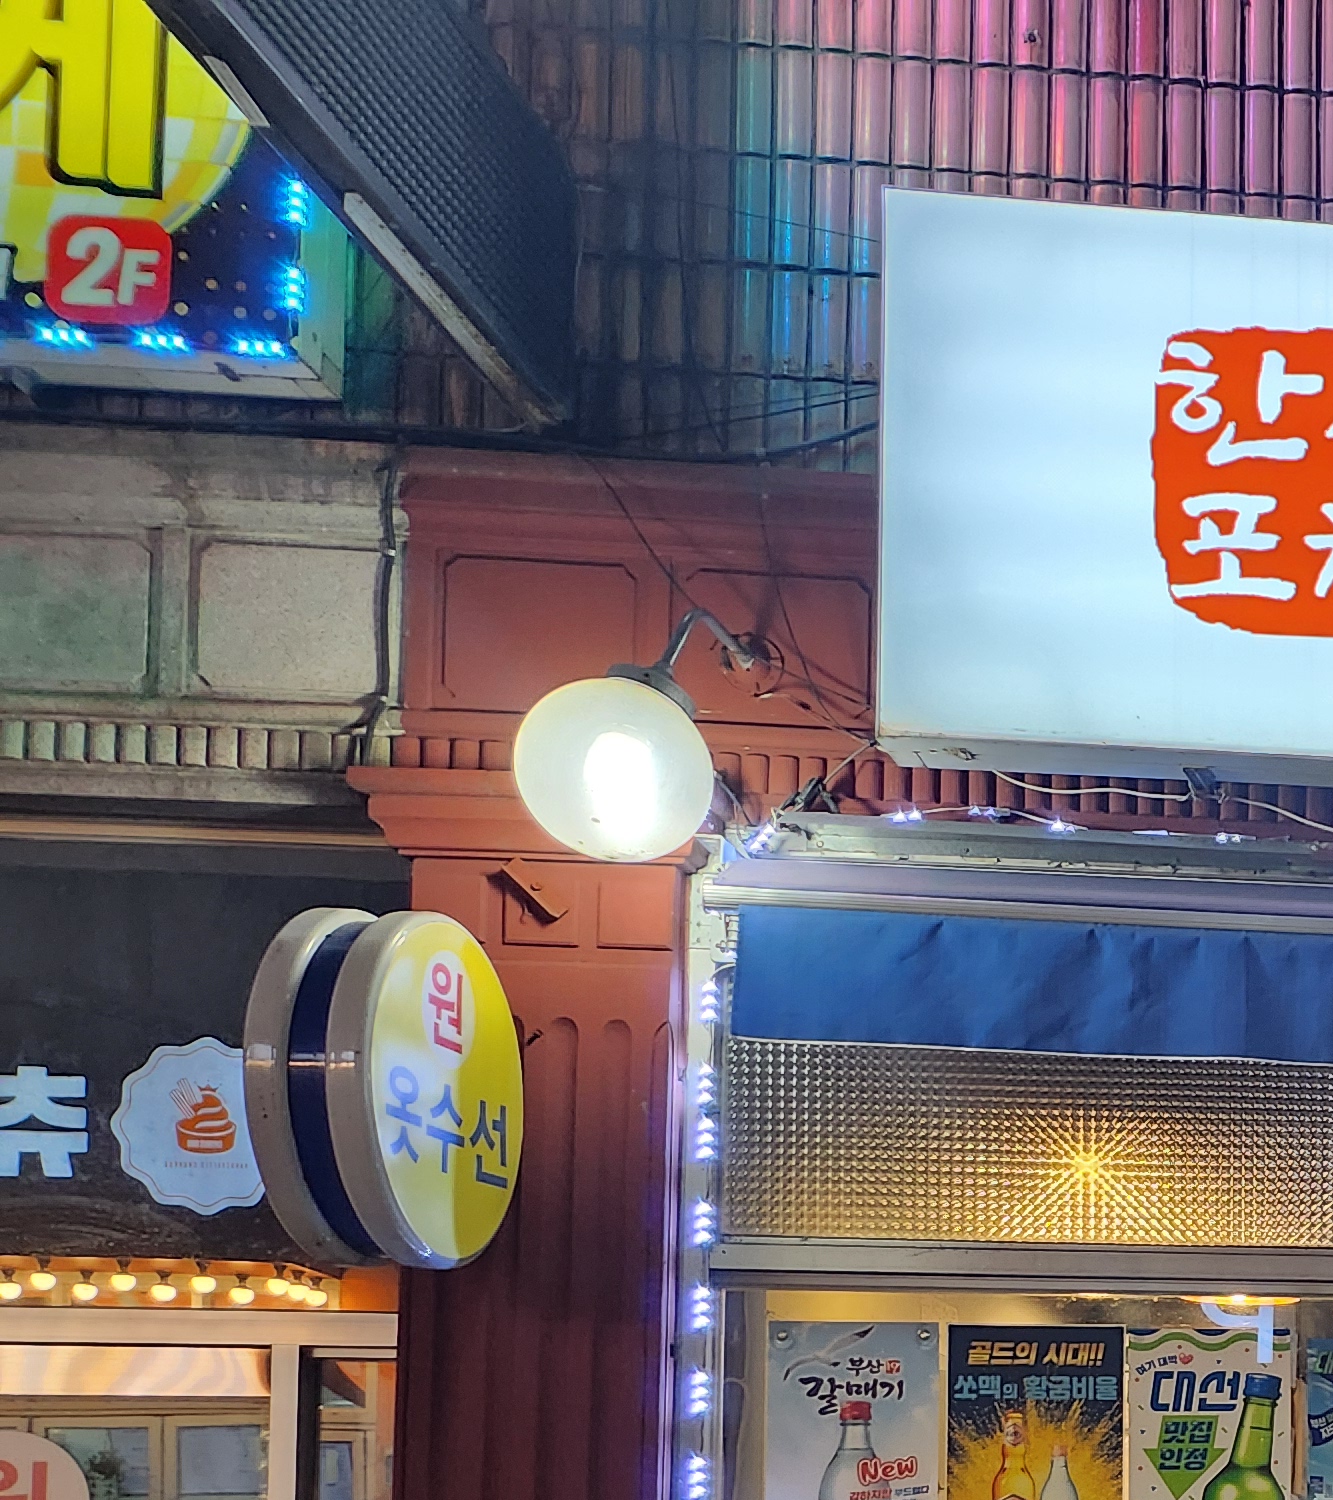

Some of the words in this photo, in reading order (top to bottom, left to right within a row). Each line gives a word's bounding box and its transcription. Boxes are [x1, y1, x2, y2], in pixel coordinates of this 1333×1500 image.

[61, 226, 160, 306] 2F
[427, 961, 464, 1055] 원
[384, 1064, 510, 1190] 옷수선
[846, 1357, 884, 1376] 부산
[967, 1341, 1039, 1366] 골드의
[1042, 1342, 1105, 1367] 시대!!
[798, 1376, 904, 1415] 갈매기
[1150, 1370, 1242, 1412] 대선
[1162, 1420, 1213, 1445] 맛집
[857, 1456, 917, 1486] New
[1158, 1447, 1207, 1472] 인정
